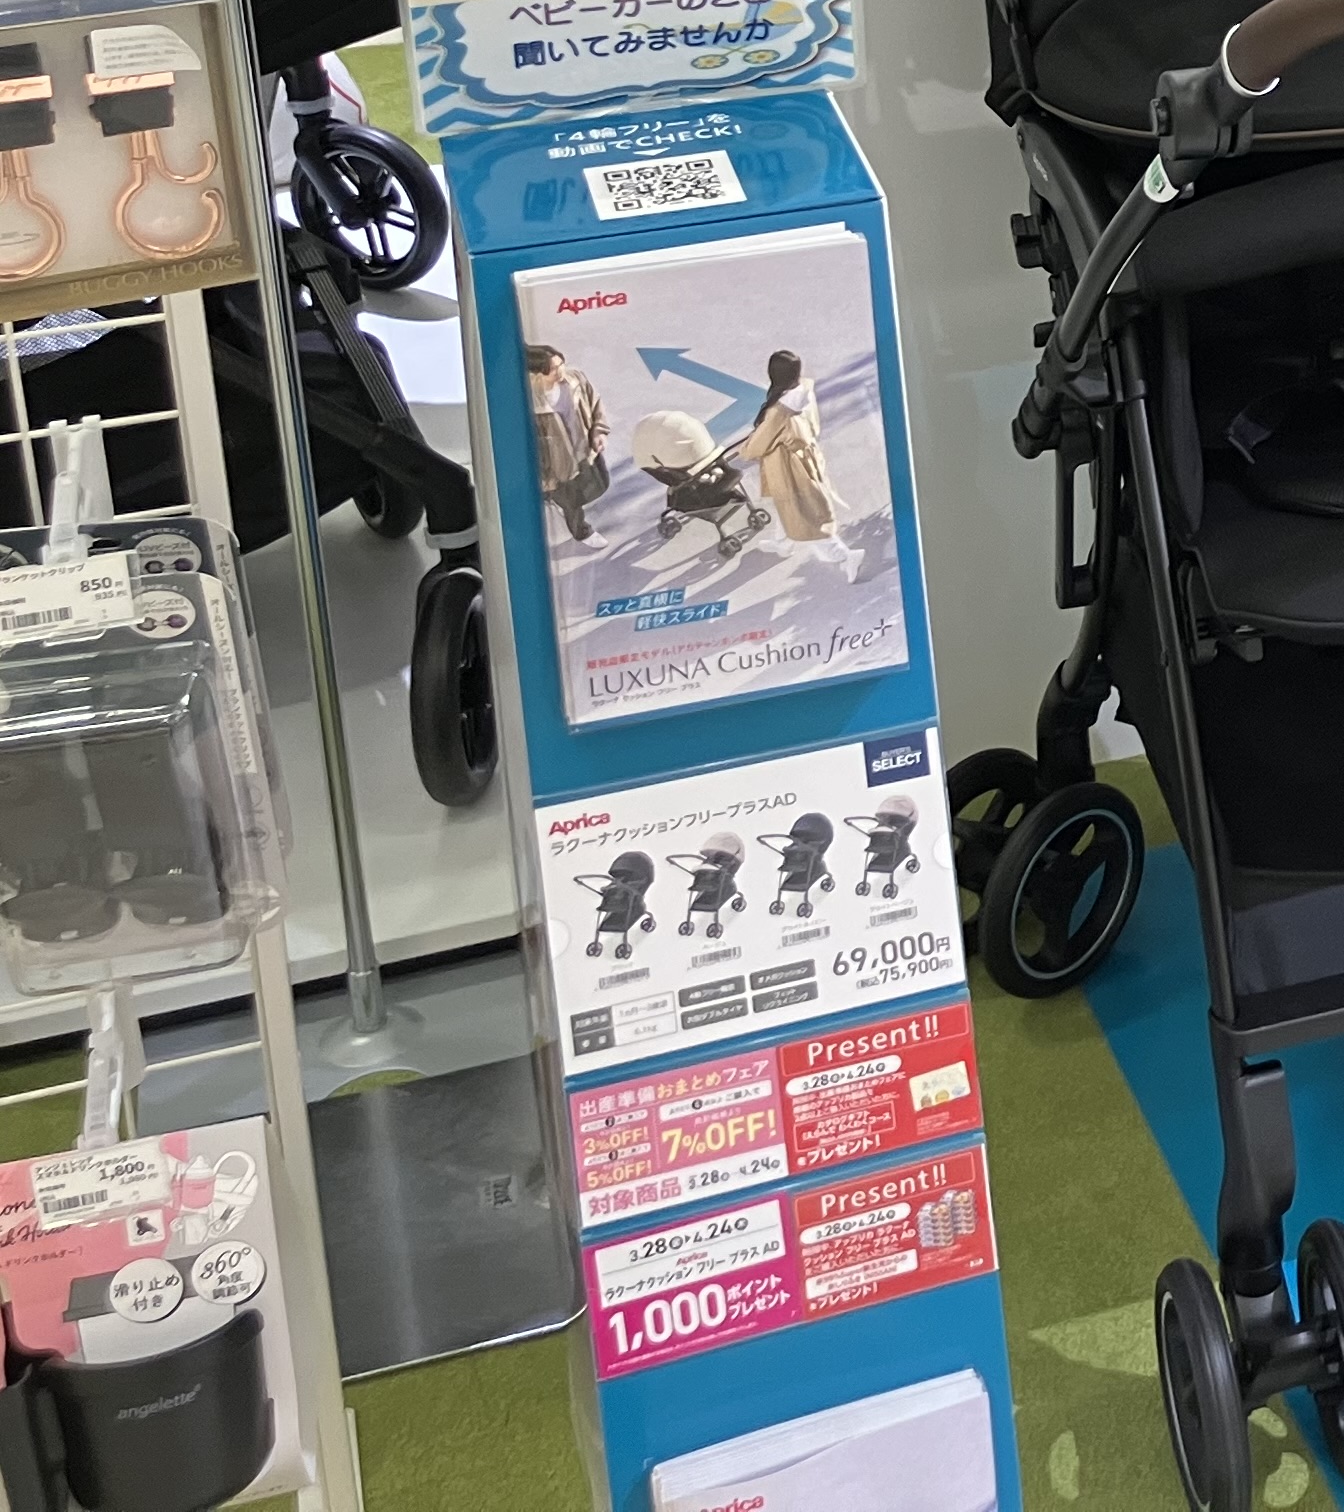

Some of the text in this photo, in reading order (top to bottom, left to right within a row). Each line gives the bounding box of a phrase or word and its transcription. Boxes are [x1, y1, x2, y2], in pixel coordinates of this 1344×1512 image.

[513, 16, 776, 70] 聞いてみませんか
[557, 289, 628, 316] Aprica
[588, 657, 711, 699] LUXUNA
[717, 638, 821, 675] Cushion
[871, 752, 923, 773] SELECT
[549, 809, 611, 837] Aprica
[832, 931, 951, 977] 69,000円
[807, 1015, 939, 1066] Present!!
[662, 1109, 777, 1163] 7%OFF!
[821, 1163, 947, 1218] Present!!
[113, 1275, 181, 1299] 滑り止め
[607, 1282, 727, 1356] 1,000
